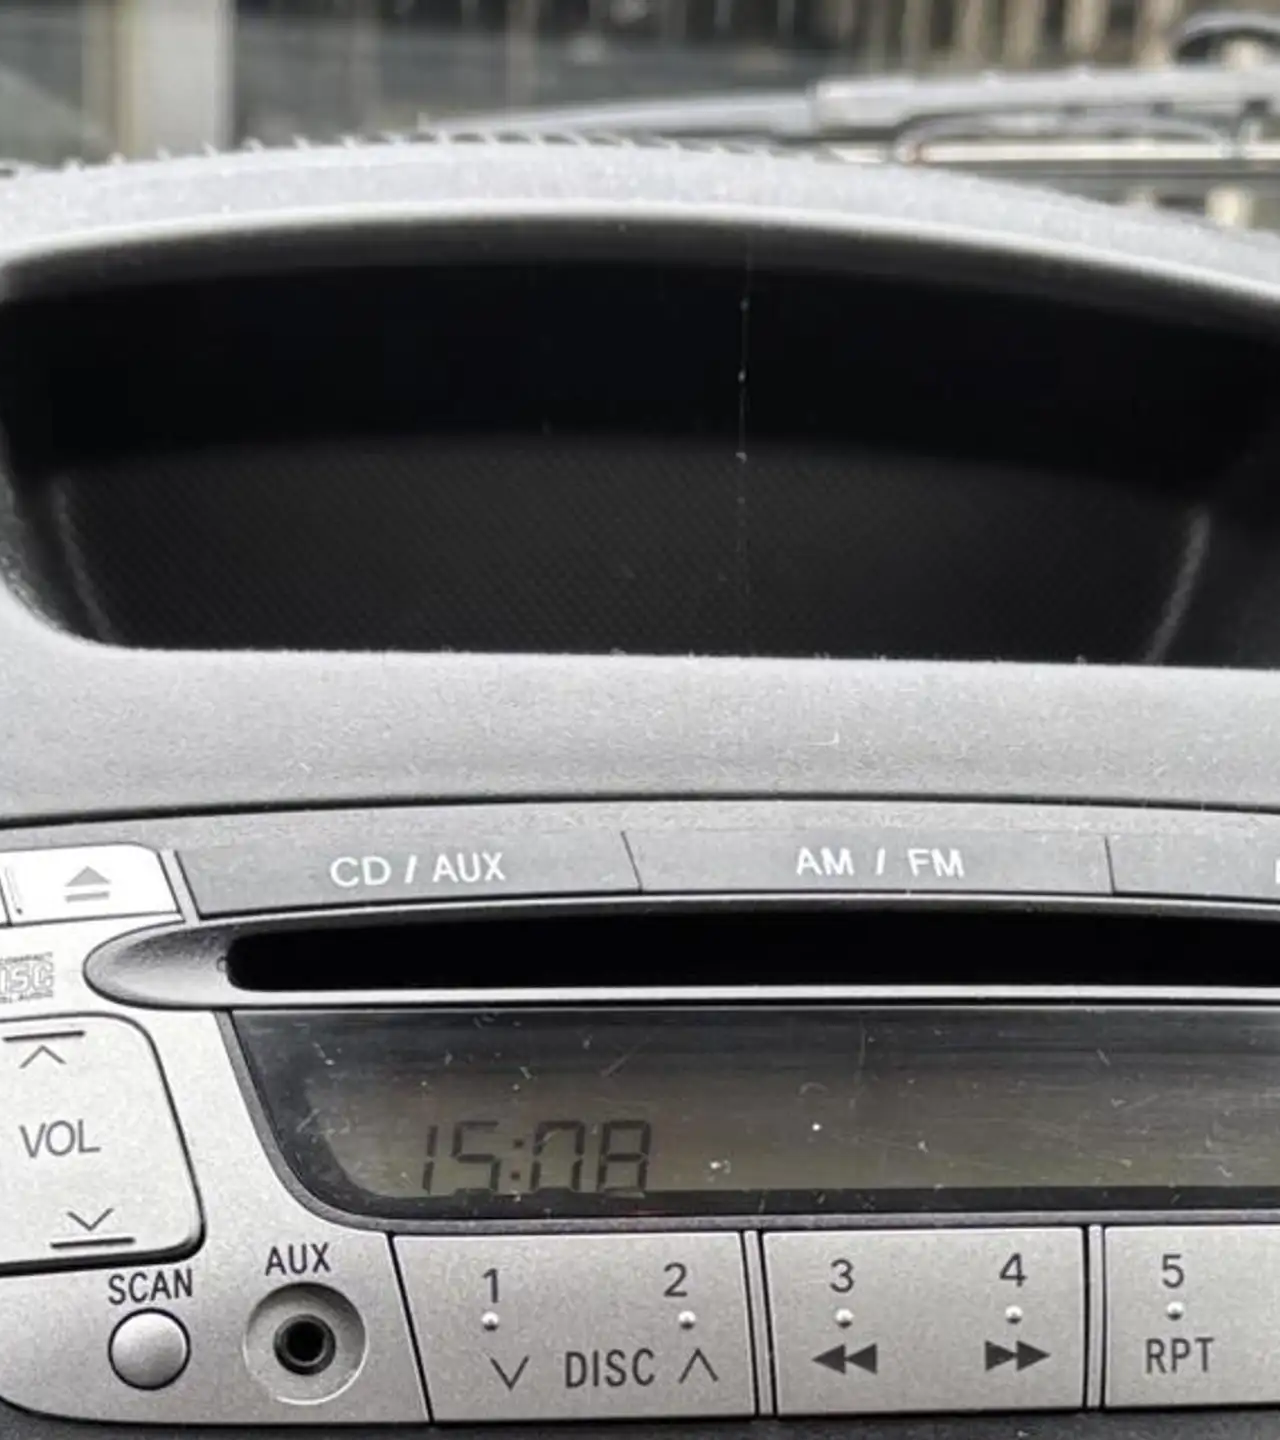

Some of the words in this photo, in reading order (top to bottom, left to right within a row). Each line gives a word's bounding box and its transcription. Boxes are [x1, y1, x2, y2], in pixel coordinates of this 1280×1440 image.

[329, 856, 392, 888] CD
[431, 853, 508, 883] AUX
[795, 847, 856, 877] AM
[907, 848, 966, 879] FM
[19, 1120, 102, 1159] VOL
[421, 1119, 653, 1196] 15:08
[264, 1241, 333, 1277] AUX
[828, 1257, 856, 1294] 3
[998, 1252, 1029, 1288] 4
[1160, 1253, 1185, 1289] 5
[107, 1267, 195, 1305] SCAN
[481, 1267, 501, 1304] 1
[662, 1262, 689, 1299] 2
[563, 1350, 657, 1388] DISC
[1144, 1336, 1215, 1374] RPT
